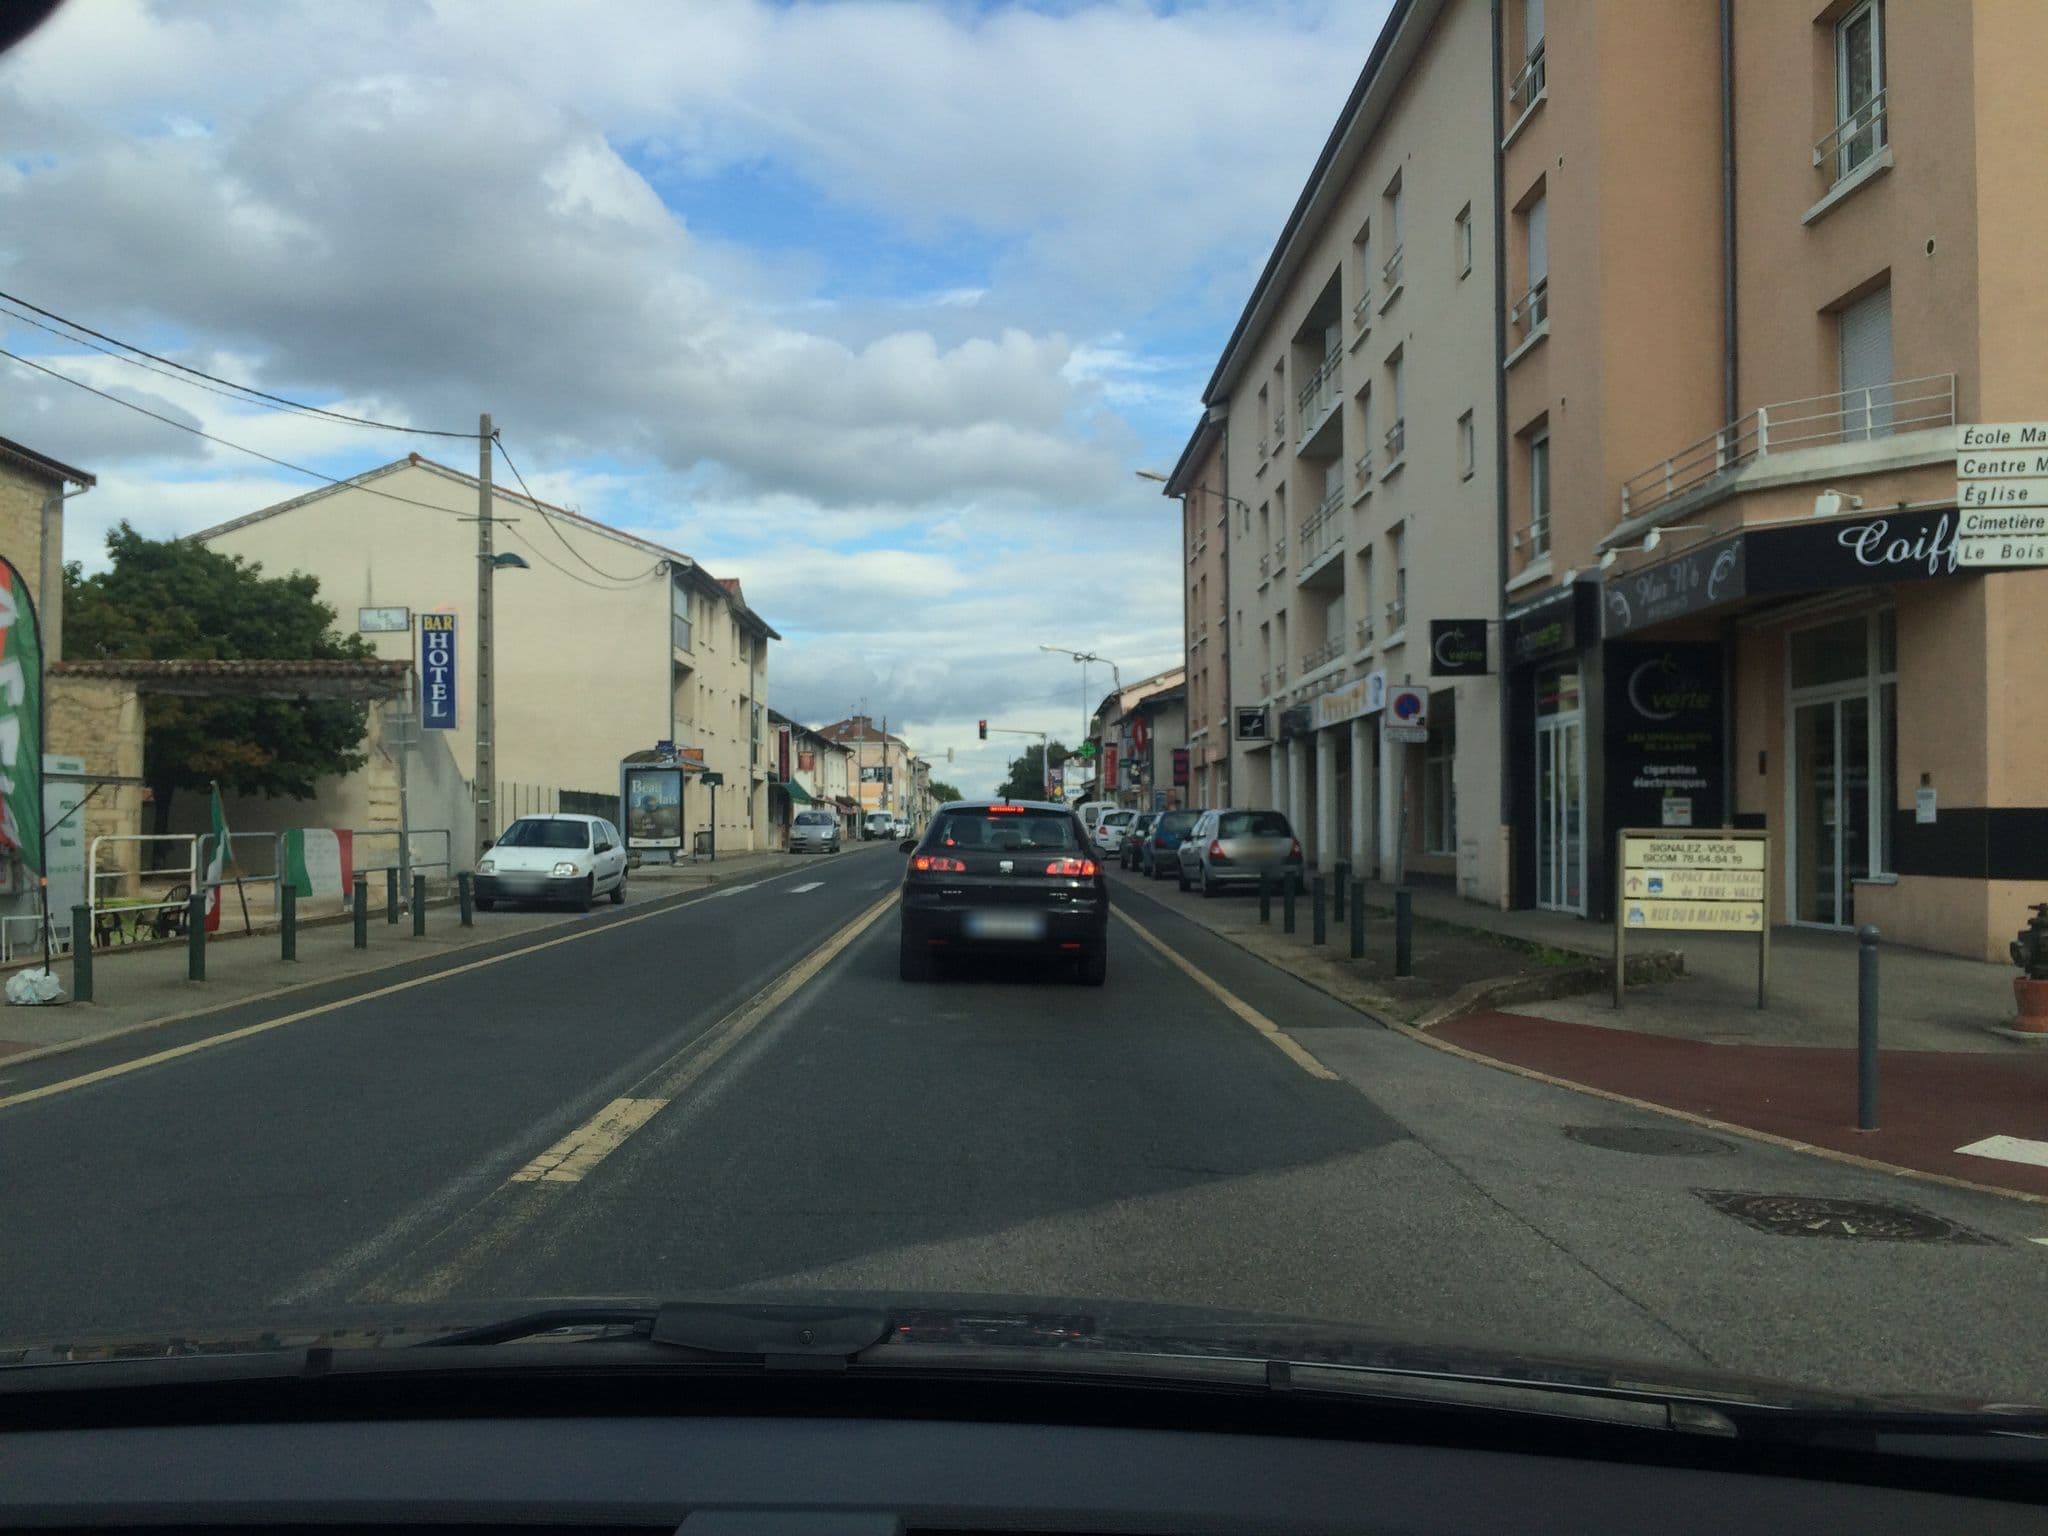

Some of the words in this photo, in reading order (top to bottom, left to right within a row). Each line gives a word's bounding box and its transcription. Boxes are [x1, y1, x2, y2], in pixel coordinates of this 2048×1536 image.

[1964, 427, 2010, 445] École
[1964, 459, 2026, 474] Centre
[1964, 483, 2029, 505] Église
[1966, 514, 2045, 530] Cimetière
[1964, 544, 1985, 560] Le
[2001, 543, 2044, 560] Bois
[423, 615, 453, 631] BAR
[428, 632, 449, 718] HOTEL
[1643, 854, 1677, 864] SICOM
[1671, 872, 1705, 883] ESPACE
[1651, 907, 1670, 921] RUE
[1671, 908, 1686, 922] DU
